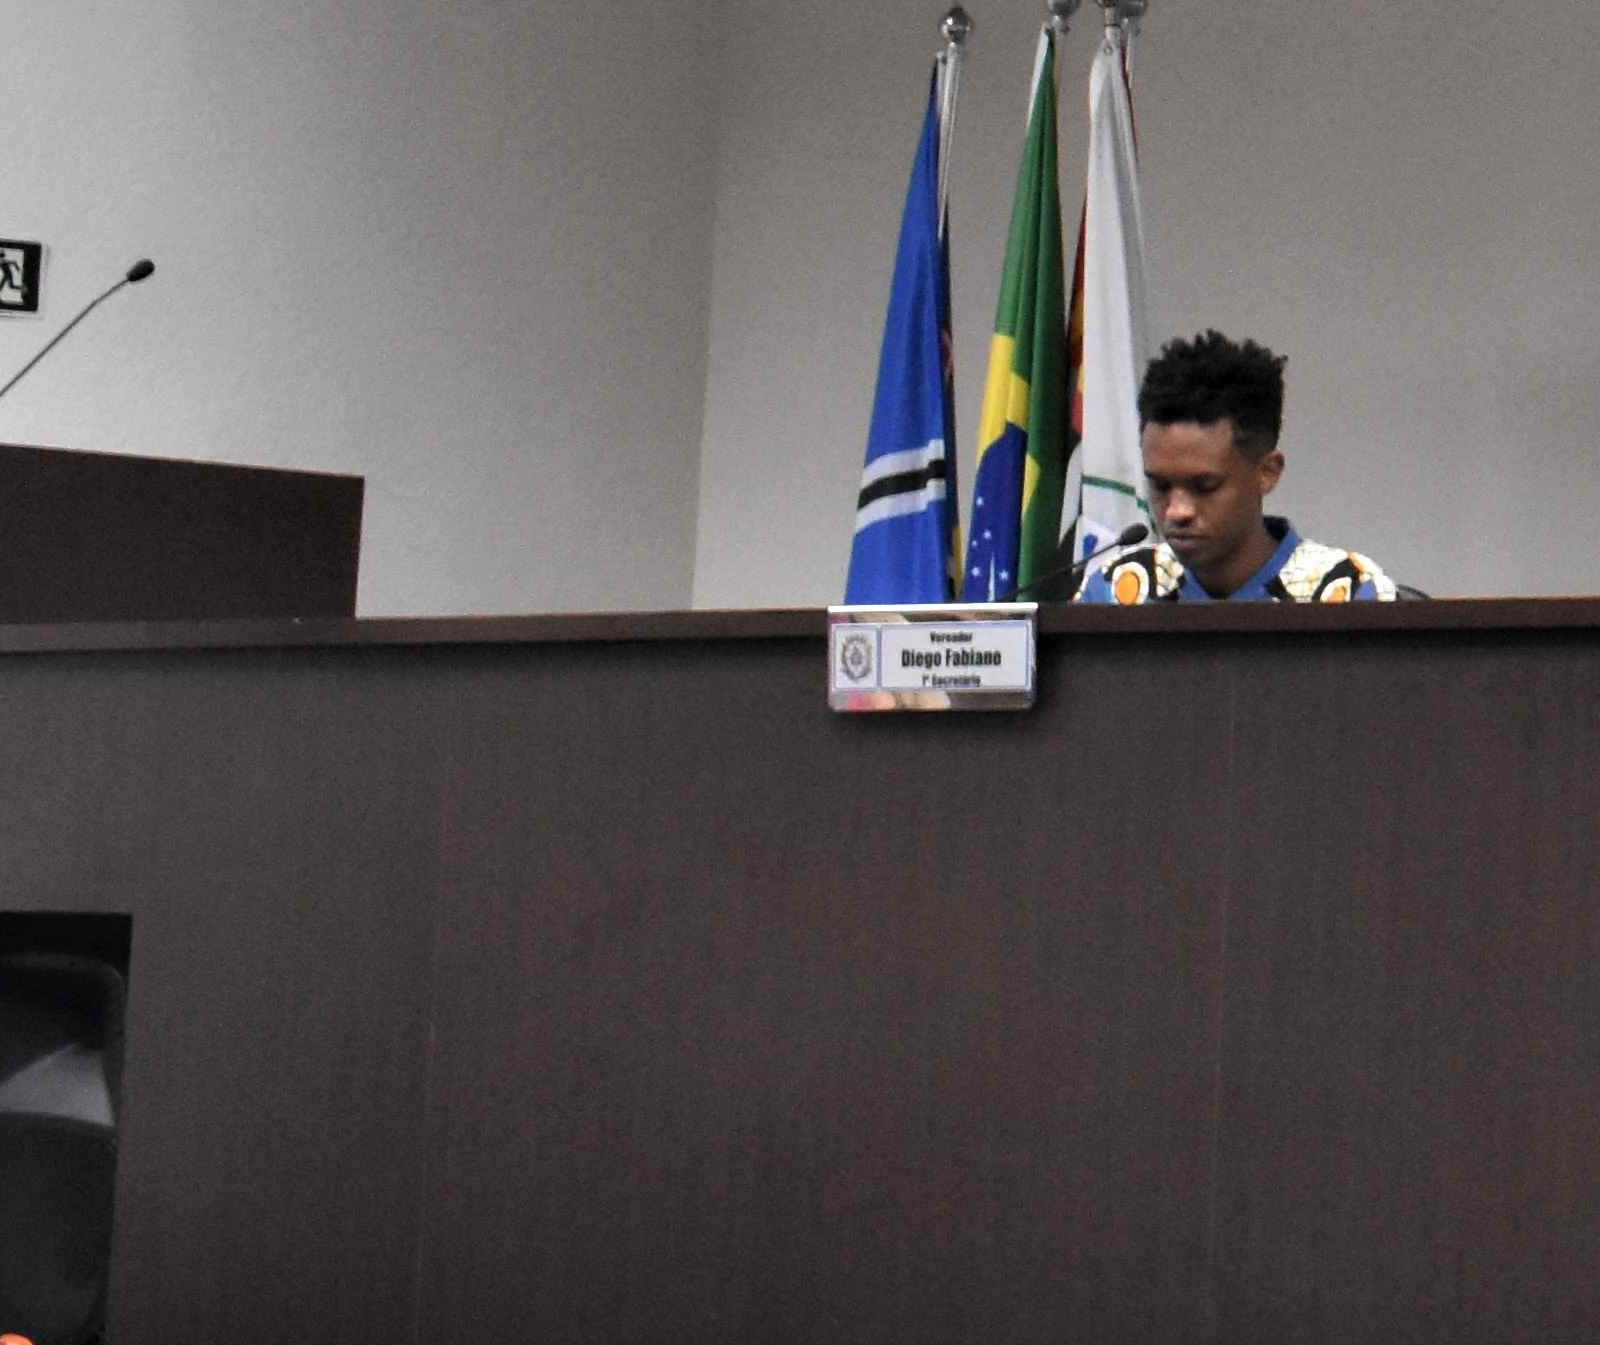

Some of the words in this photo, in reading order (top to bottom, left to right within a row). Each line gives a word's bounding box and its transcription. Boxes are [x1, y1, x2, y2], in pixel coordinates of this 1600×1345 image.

[929, 630, 974, 643] Vereador
[900, 647, 942, 669] Diego
[945, 647, 1002, 667] Fabiano
